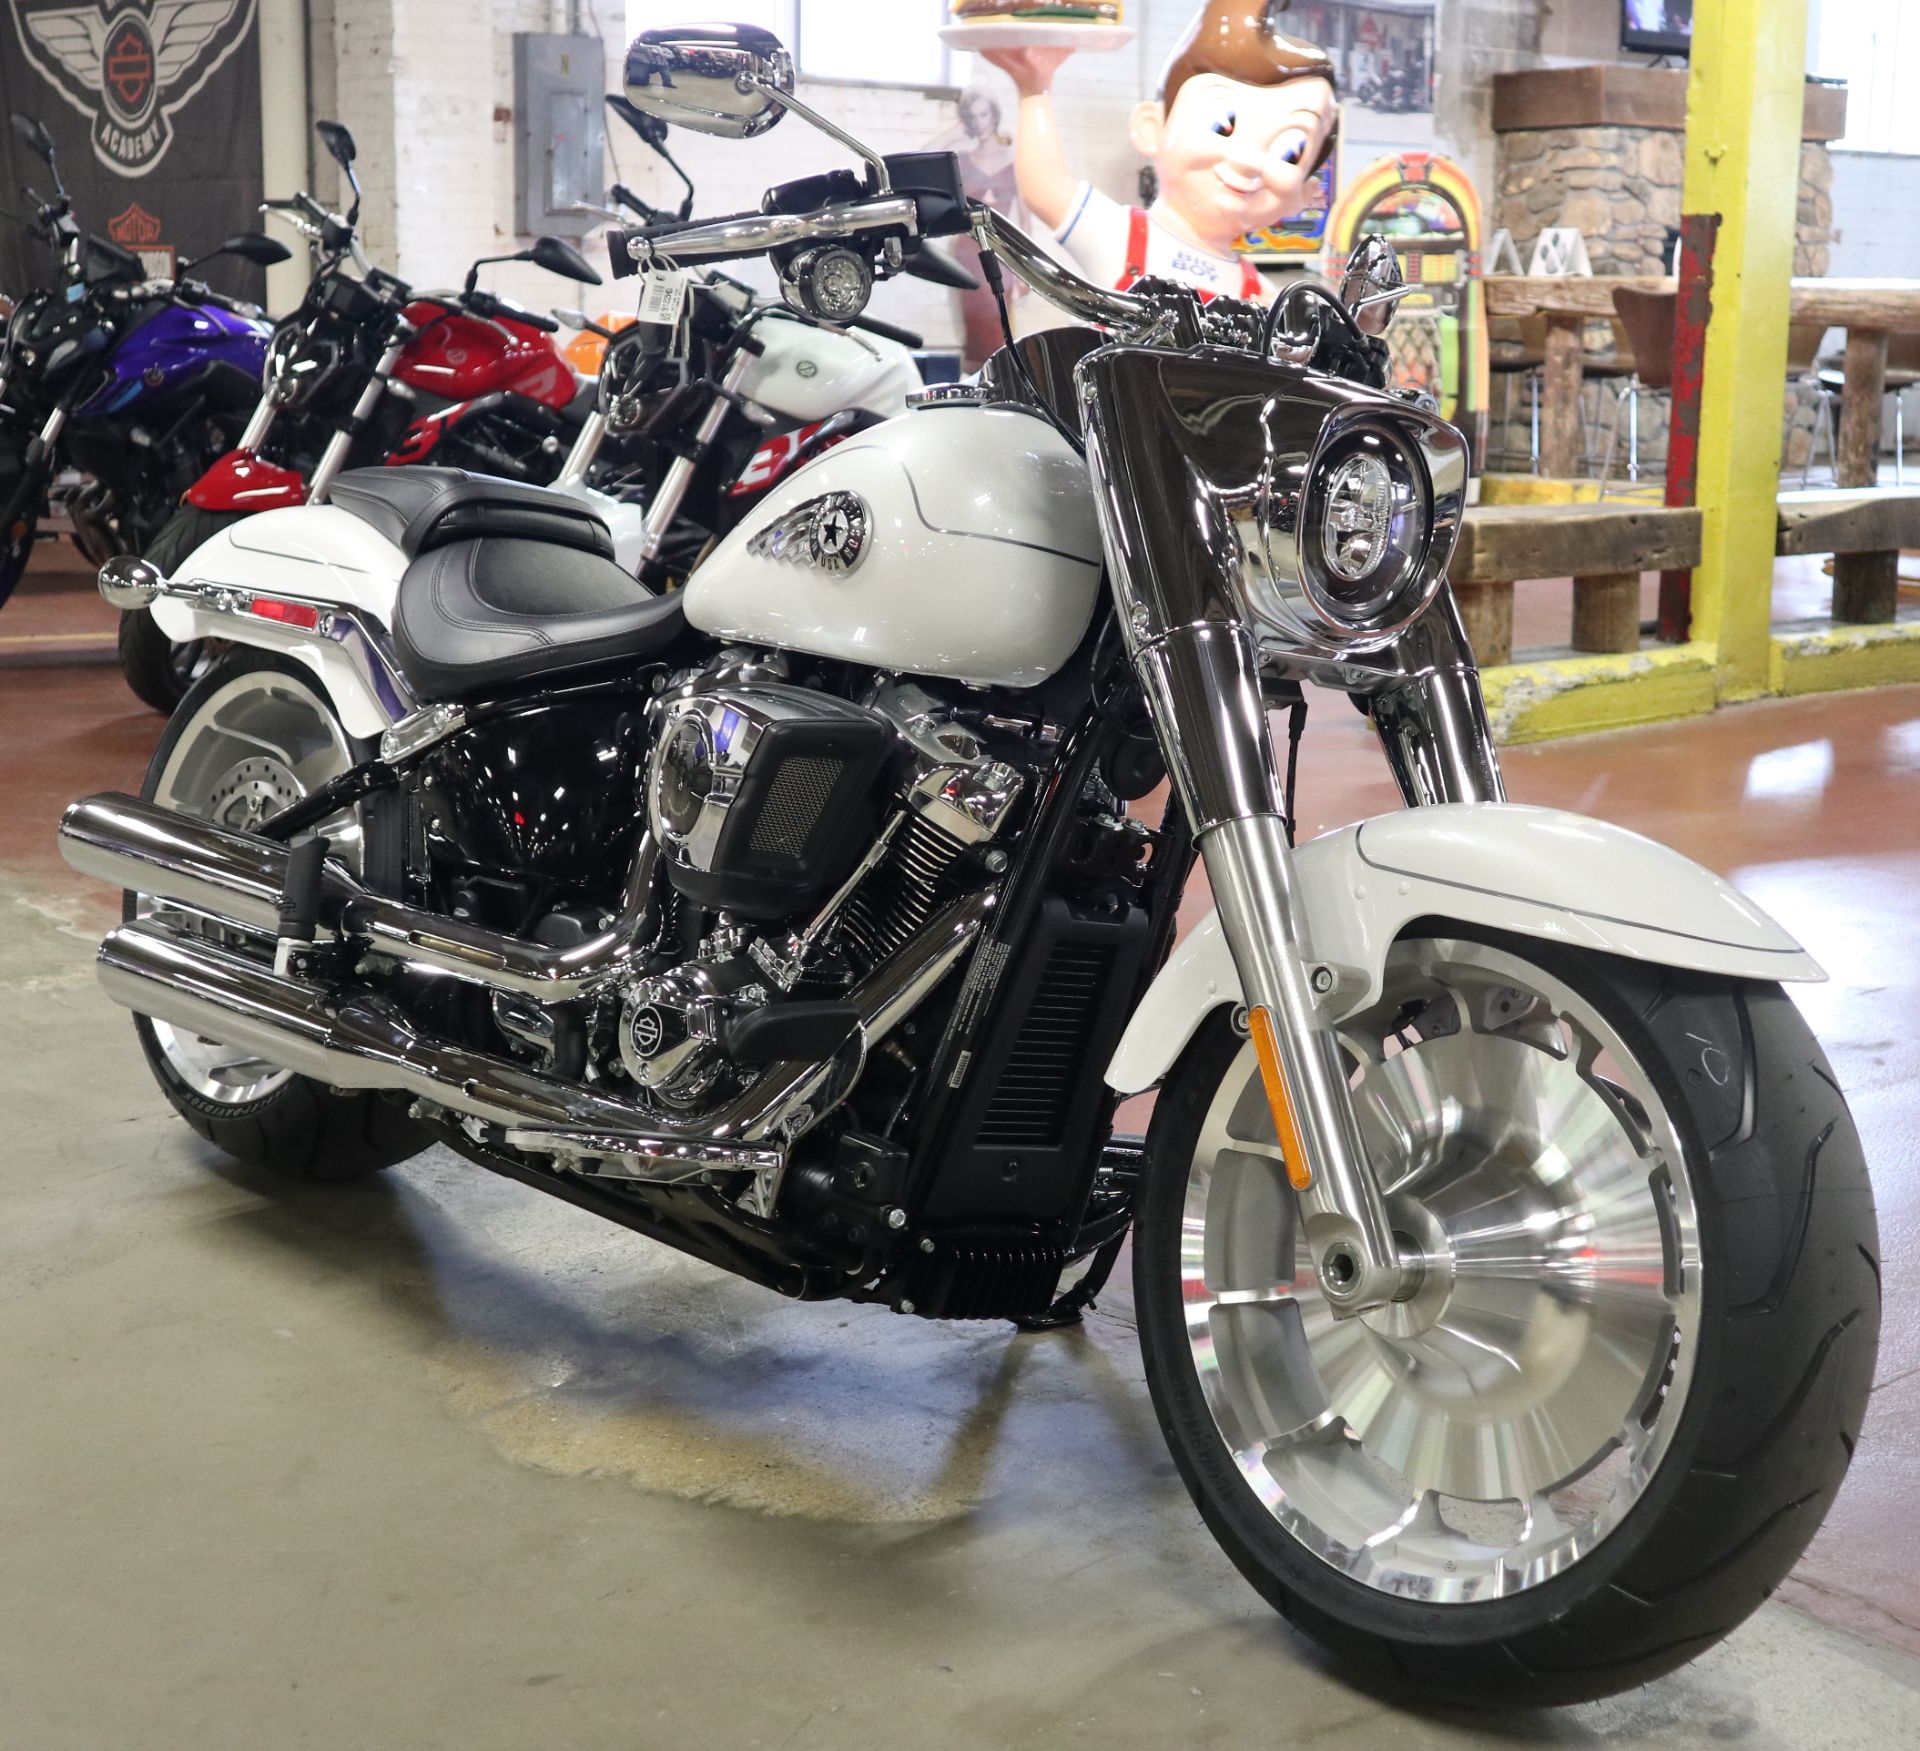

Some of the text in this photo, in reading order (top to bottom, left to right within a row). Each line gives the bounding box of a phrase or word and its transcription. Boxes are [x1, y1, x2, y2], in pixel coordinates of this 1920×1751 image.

[100, 117, 160, 160] ACADEMY
[1172, 259, 1219, 281] BOY
[1177, 250, 1216, 271] BIG
[820, 555, 840, 570] USA
